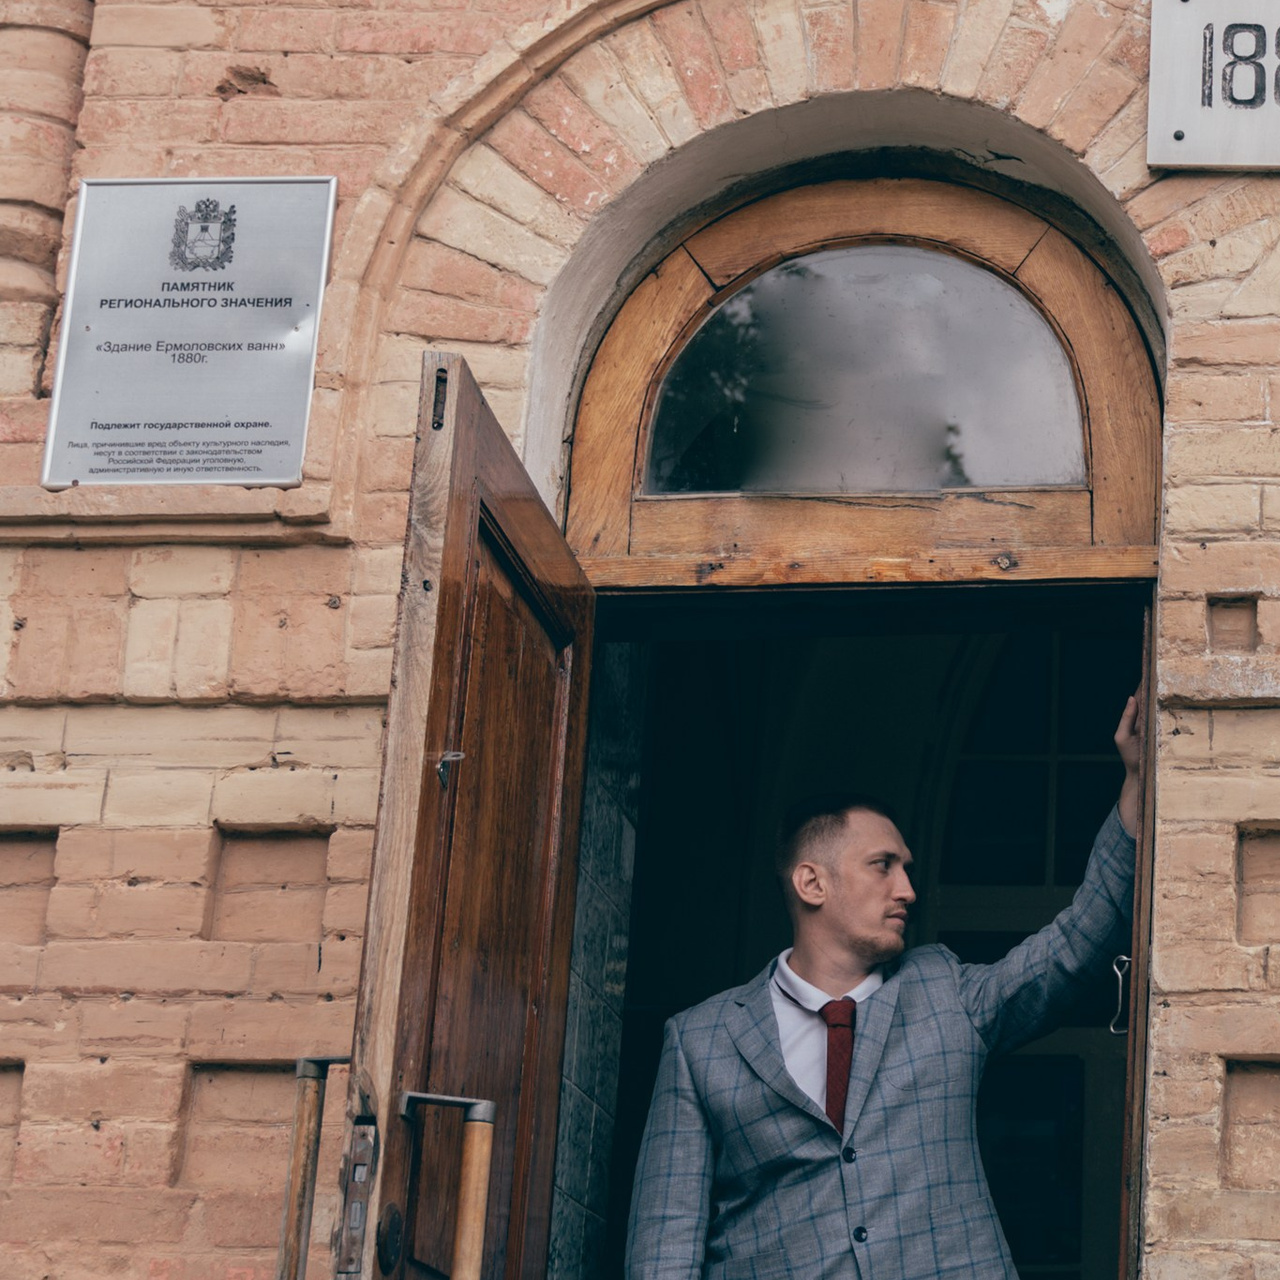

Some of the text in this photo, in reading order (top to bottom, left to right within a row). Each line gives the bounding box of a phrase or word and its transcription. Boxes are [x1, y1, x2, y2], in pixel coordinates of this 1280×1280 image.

[161, 281, 235, 292] ПАМЯТНИК
[99, 297, 293, 309] РЕГИОНАЛЬНОГО ЗНАЧЕНИЯ
[96, 340, 286, 353] «Здание Ермоловских ванн»
[170, 352, 208, 364] 1880г.
[90, 420, 272, 430] Подлежит государственной охране.
